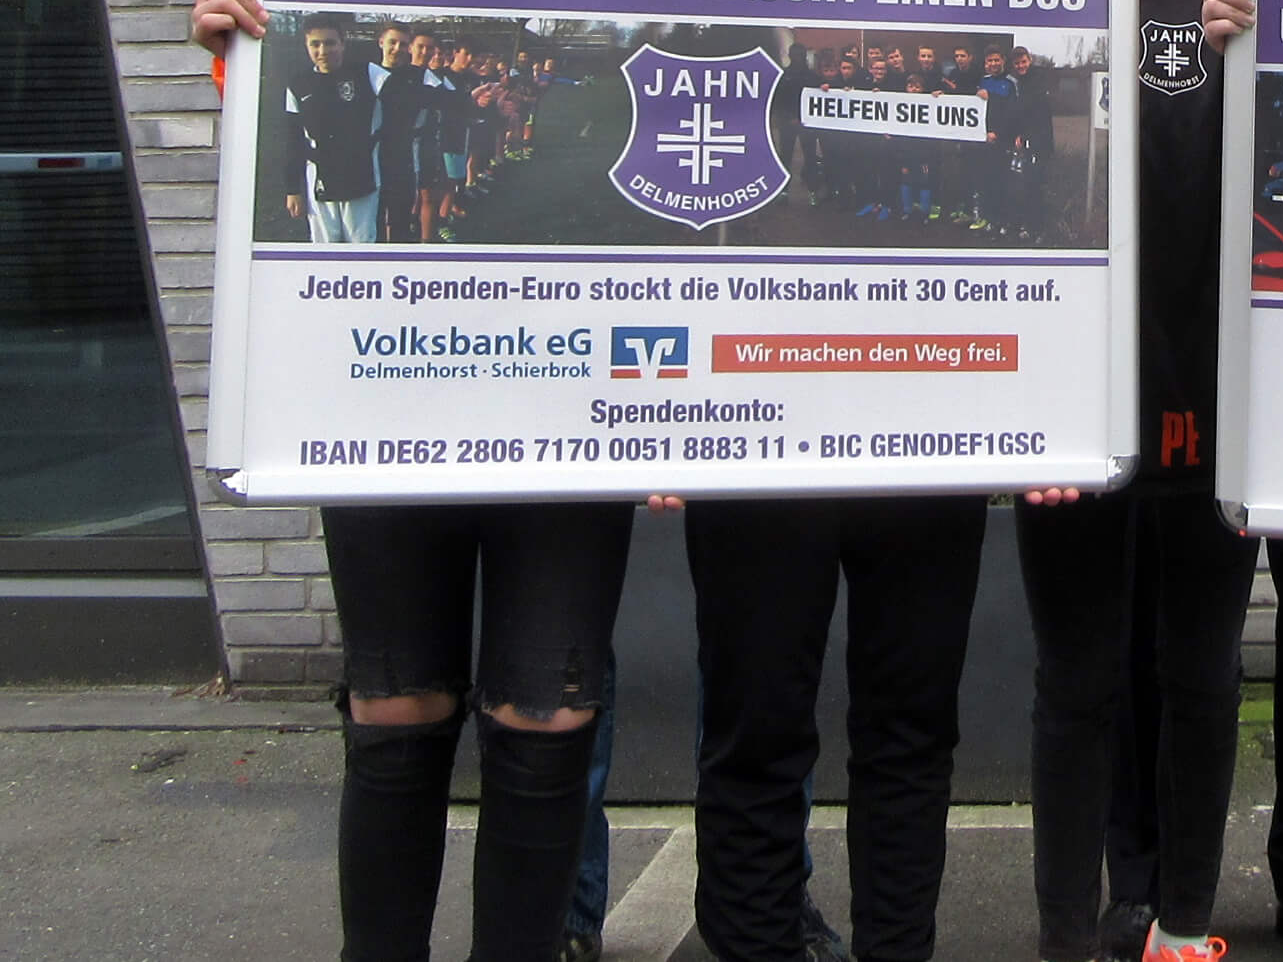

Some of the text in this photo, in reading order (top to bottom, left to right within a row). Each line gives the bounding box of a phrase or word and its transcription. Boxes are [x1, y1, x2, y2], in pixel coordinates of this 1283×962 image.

[1150, 29, 1196, 43] JAHN
[643, 68, 760, 99] JAHN
[1143, 72, 1200, 88] DELMENHORST
[808, 96, 979, 128] HELFEN SIE UNS
[629, 174, 769, 212] DELMENHORST
[299, 275, 1061, 305] Jeden Spenden-Euro stockt die Volksbank mit 30 Cent auf.
[351, 326, 592, 356] Volksbank eG
[735, 342, 1007, 367] Wir machen den Weg frei.
[351, 362, 477, 379] Delmenhorst
[491, 361, 591, 379] Schierbrok
[590, 398, 784, 429] Spendenkonto:
[300, 440, 367, 465] IBAN
[377, 439, 447, 464] DE62
[456, 438, 524, 463] 2806
[534, 437, 600, 463] 7170
[609, 437, 671, 462] 0051
[683, 436, 747, 460] 8883
[758, 436, 785, 459] 11
[820, 434, 862, 458] BIC
[870, 432, 1046, 457] GENODEF1GSC
